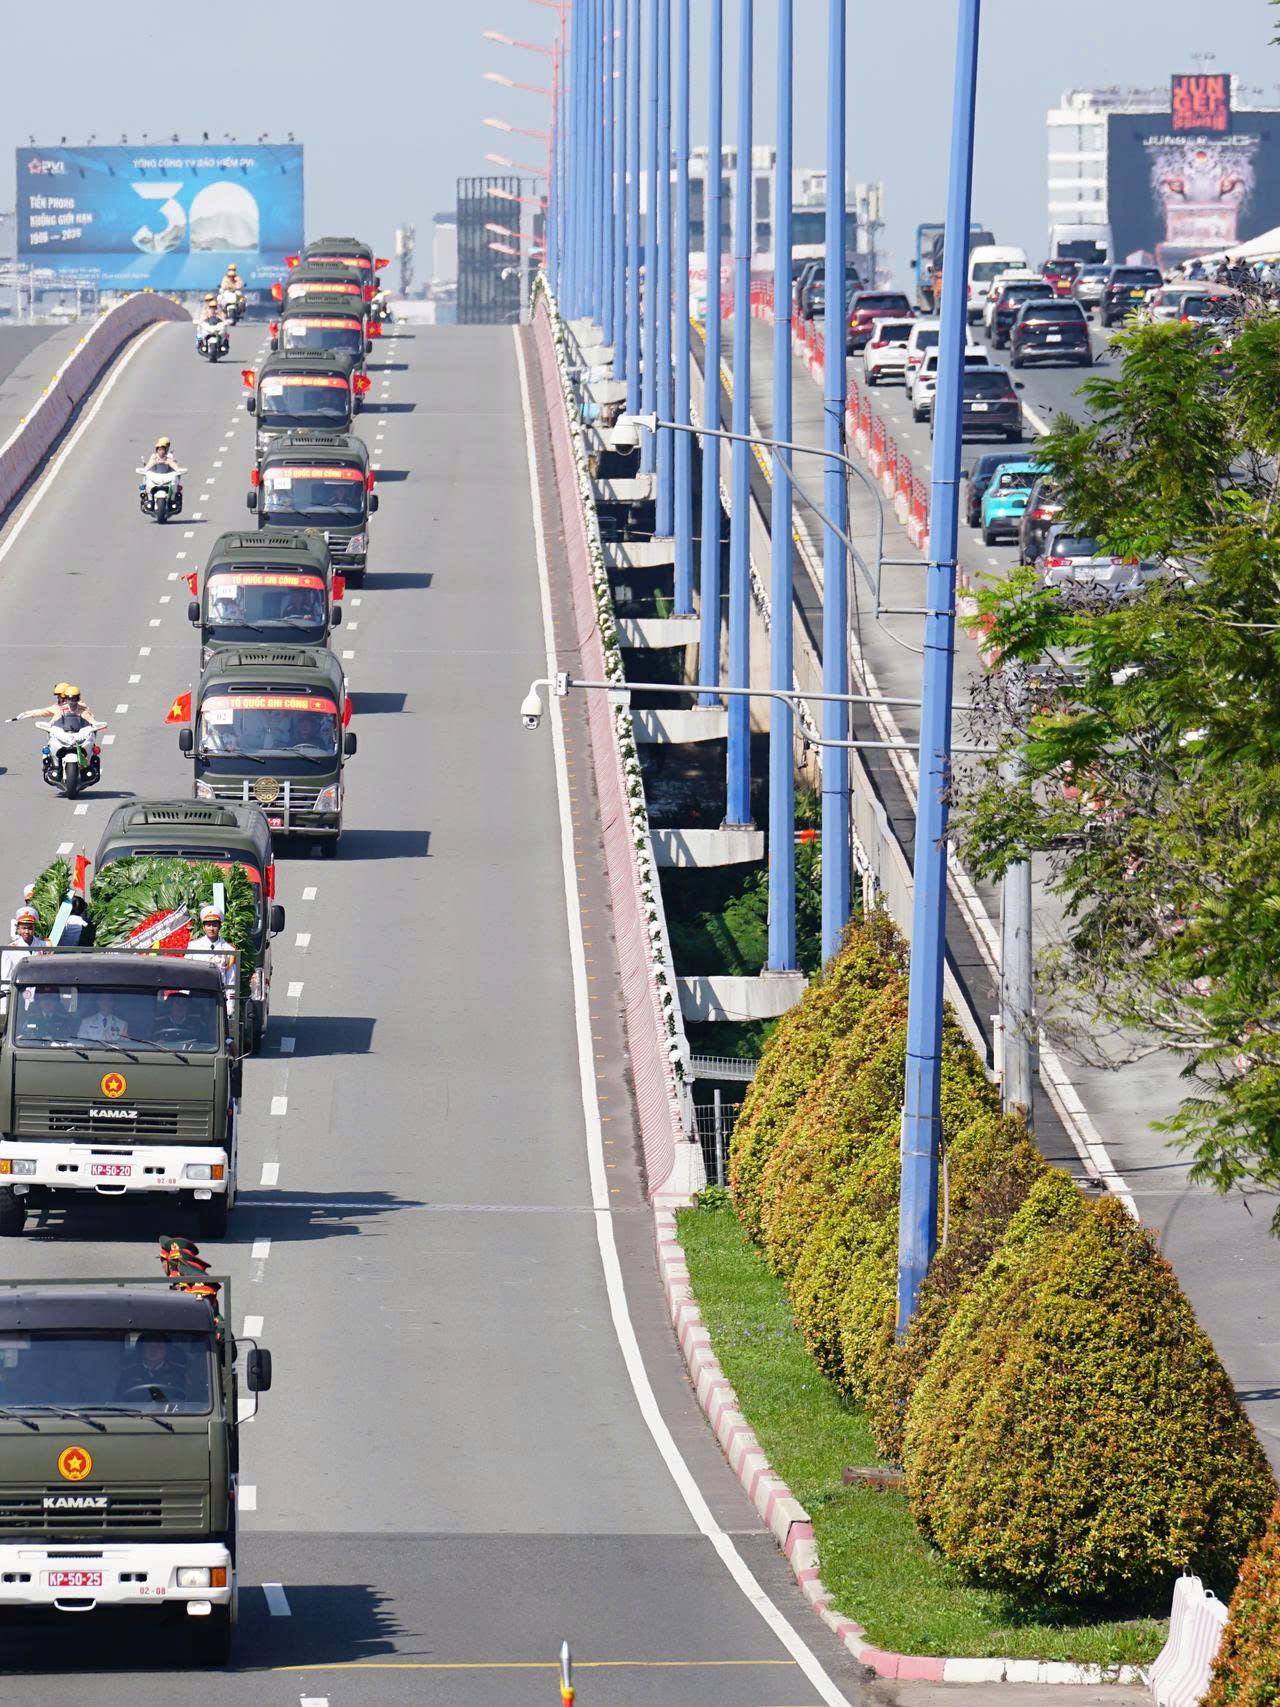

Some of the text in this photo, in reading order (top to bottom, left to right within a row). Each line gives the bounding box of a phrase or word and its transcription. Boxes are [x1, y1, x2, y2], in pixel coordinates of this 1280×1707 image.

[89, 1109, 138, 1119] KAMAZ
[92, 1165, 131, 1176] KP-50-20
[43, 1497, 108, 1508] KAMAZ
[49, 1571, 101, 1586] KP-50-25
